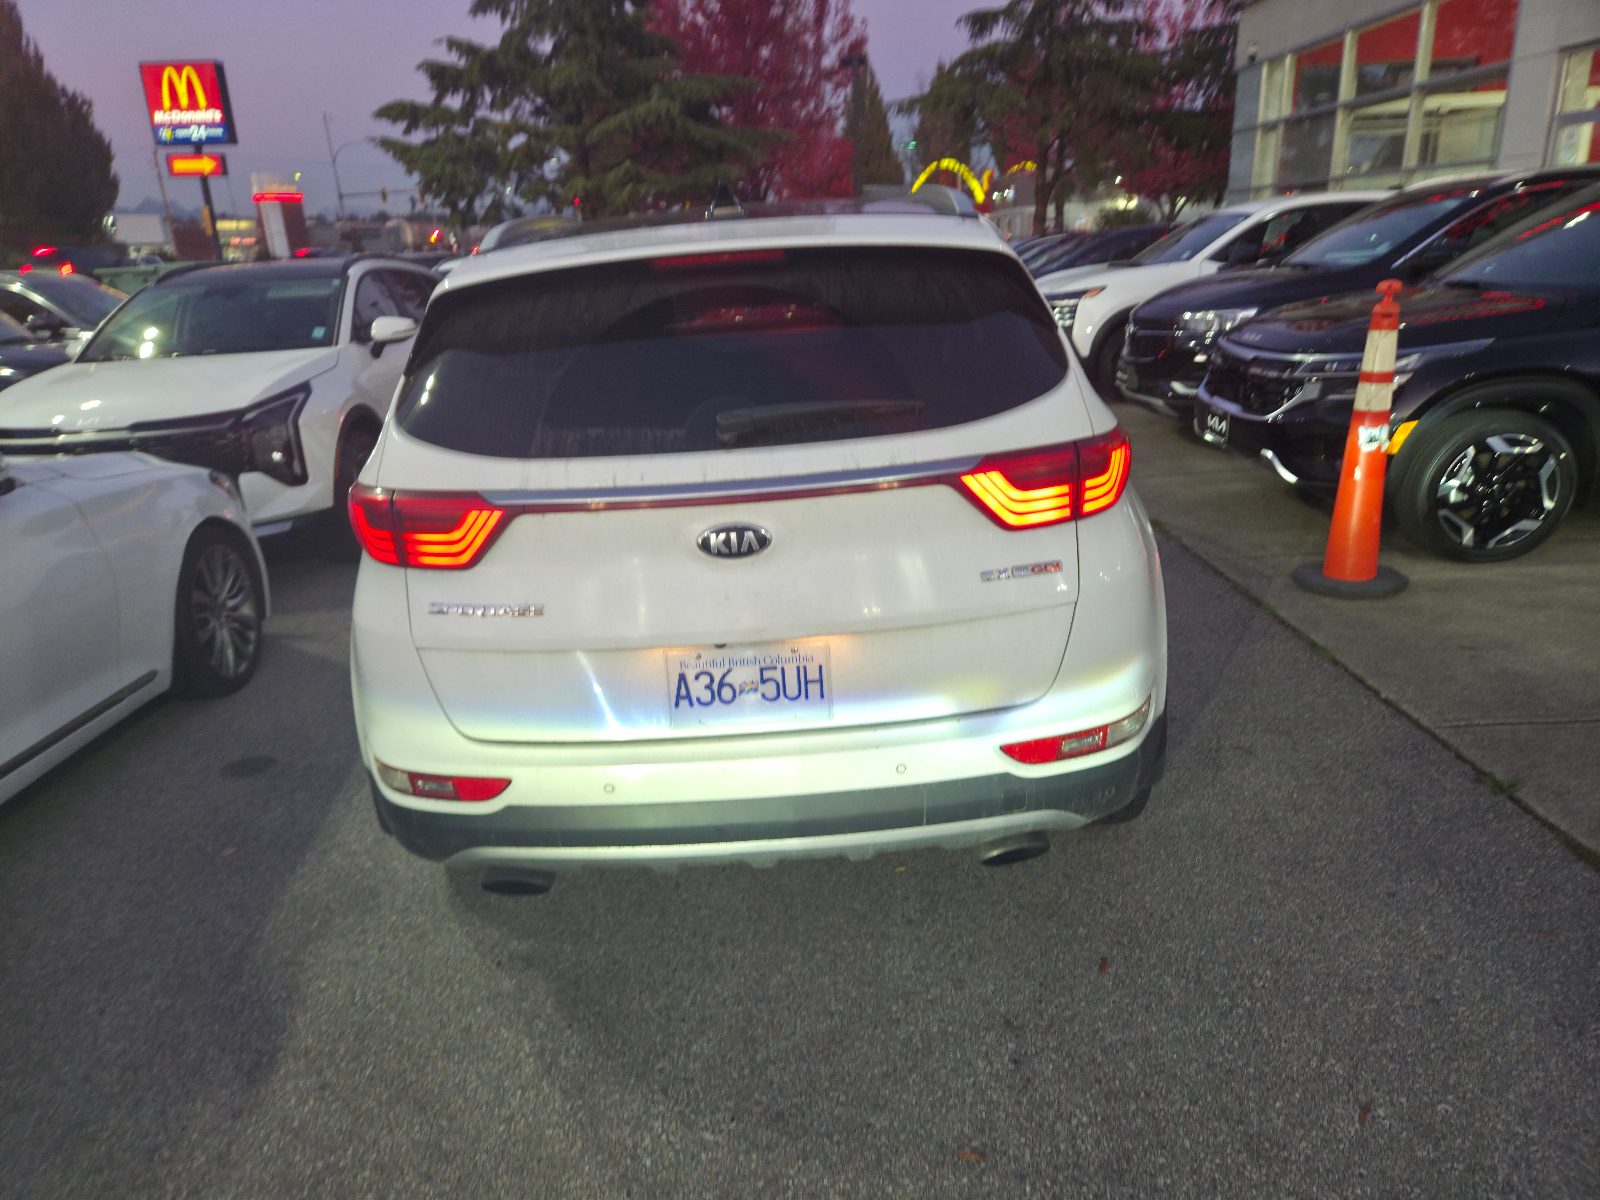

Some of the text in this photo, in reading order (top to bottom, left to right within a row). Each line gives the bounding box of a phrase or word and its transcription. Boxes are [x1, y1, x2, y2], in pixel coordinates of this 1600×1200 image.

[709, 531, 760, 555] KIA
[680, 653, 814, 670] Beautiful British Columbia
[674, 664, 824, 708] A36 5UH
